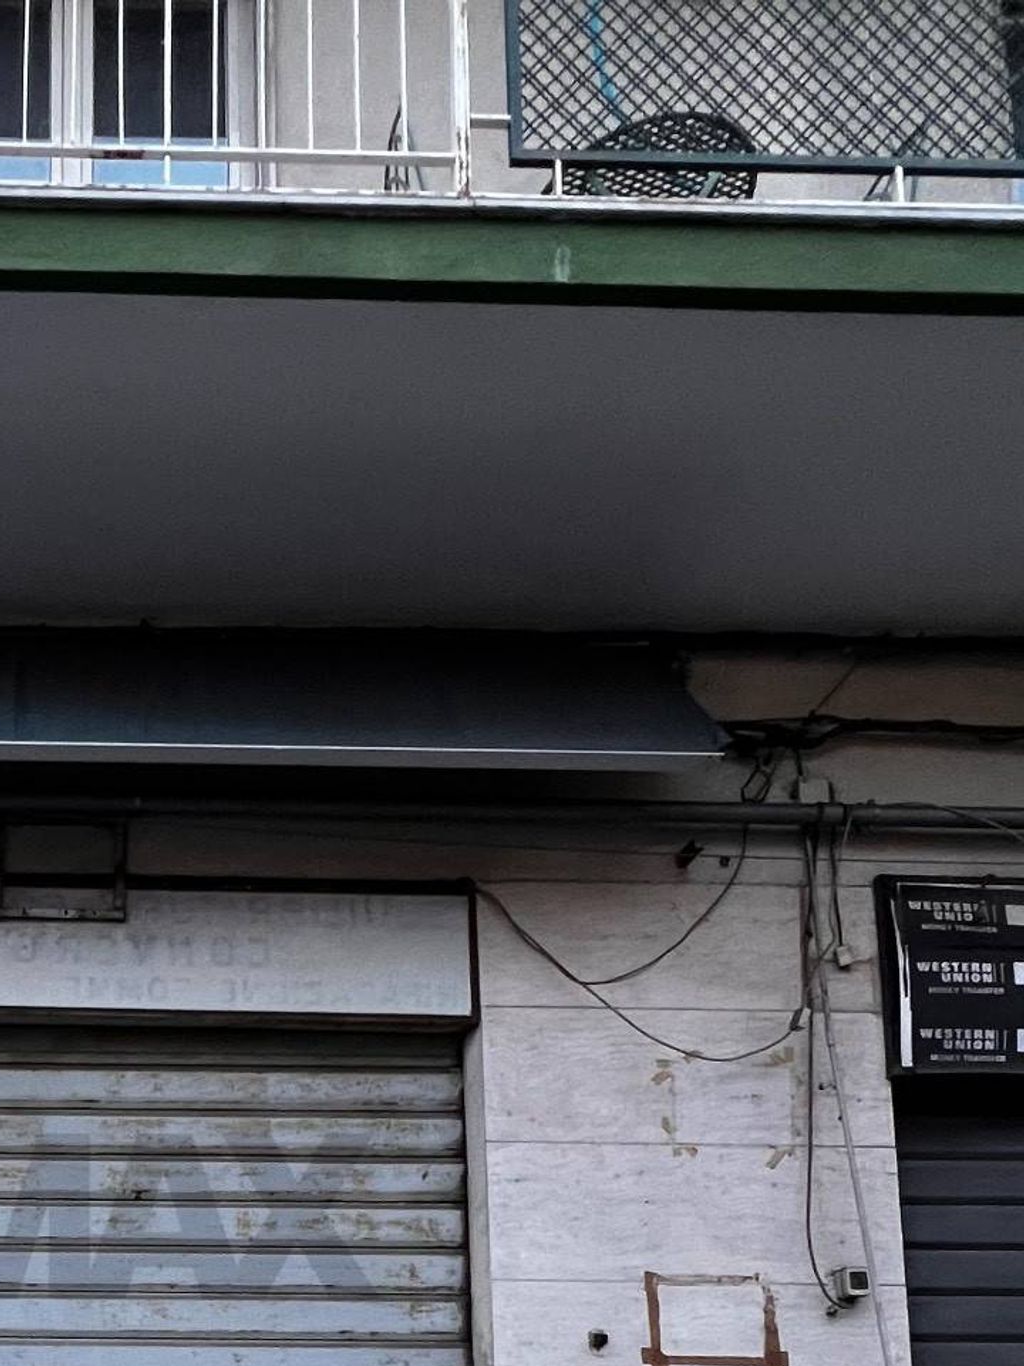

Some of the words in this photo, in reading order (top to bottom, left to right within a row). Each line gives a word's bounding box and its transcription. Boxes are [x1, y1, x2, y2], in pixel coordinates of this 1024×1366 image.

[933, 911, 974, 921] UNIO
[916, 962, 992, 972] WESTERN
[941, 973, 993, 983] UNION
[920, 1028, 996, 1039] WESTERN
[943, 1040, 996, 1050] UNION
